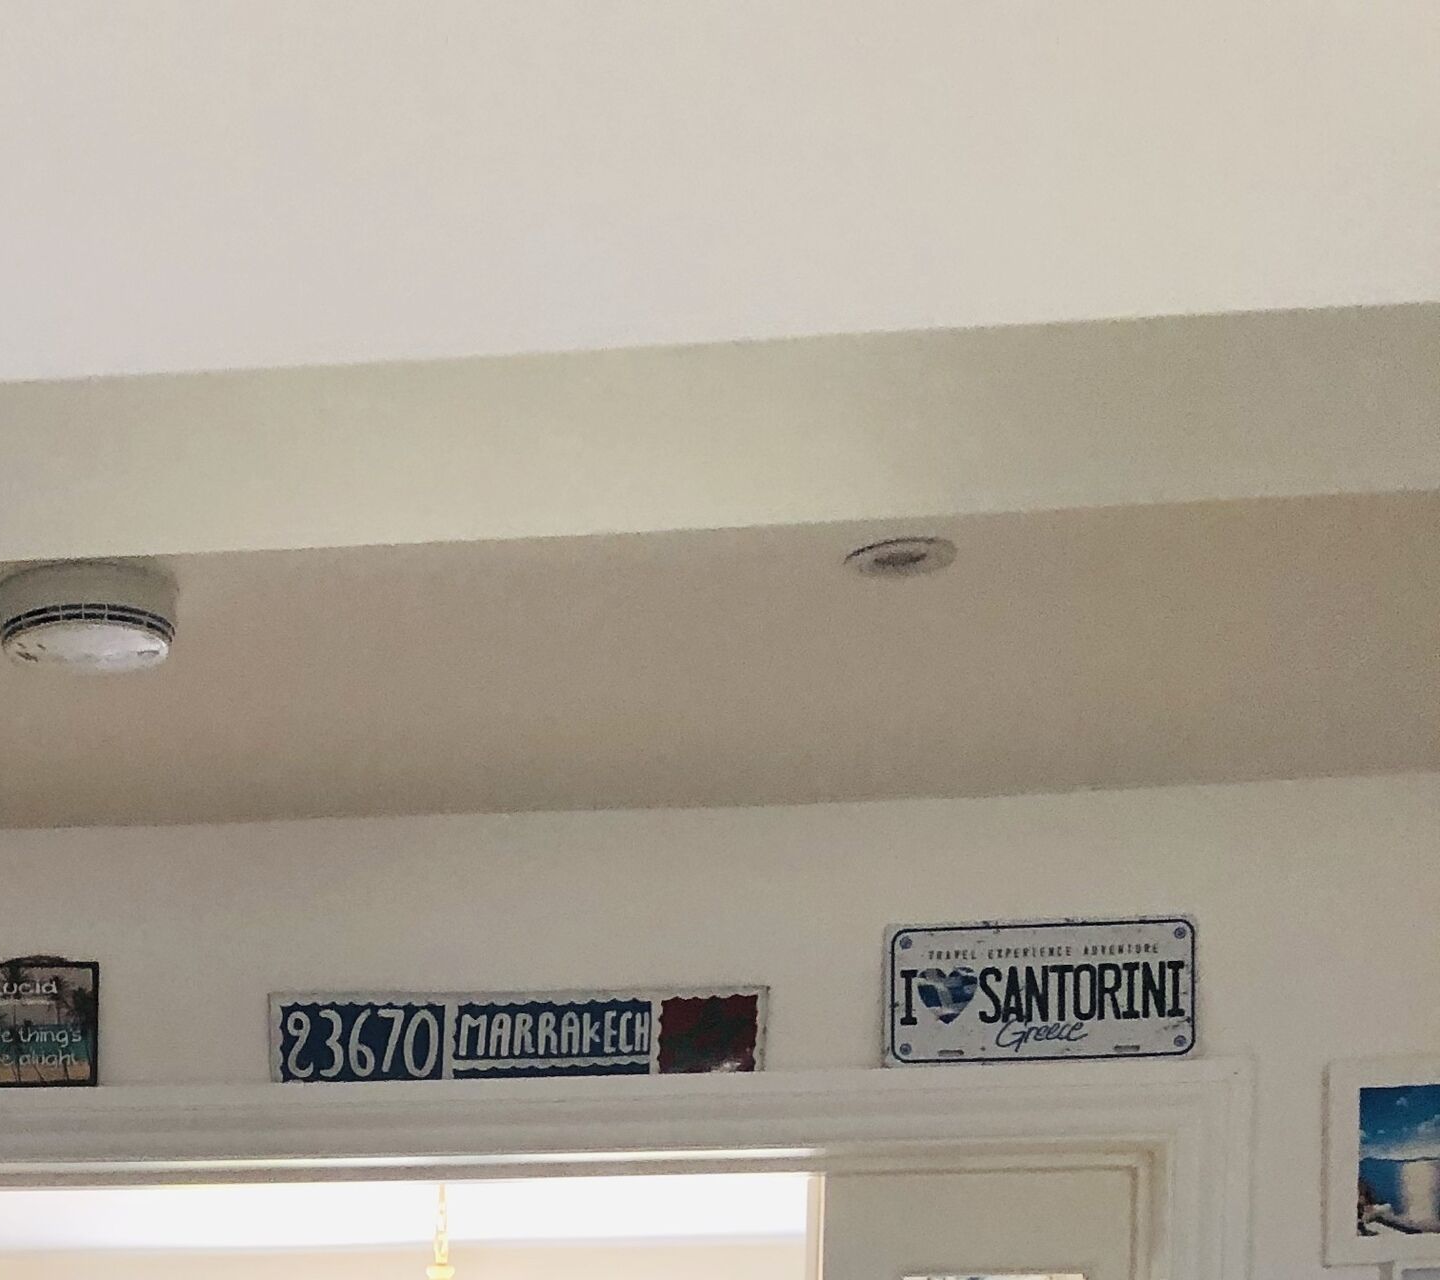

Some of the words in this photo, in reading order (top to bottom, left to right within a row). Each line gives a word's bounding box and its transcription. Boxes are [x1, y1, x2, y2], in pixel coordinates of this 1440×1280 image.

[927, 948, 977, 960] TRAVEL
[987, 945, 1072, 959] EXPERIENCE
[1083, 942, 1159, 955] ADVENTURE
[899, 969, 918, 1026] I
[978, 960, 1186, 1025] SANTORINI
[18, 1026, 82, 1048] thing's
[287, 1008, 440, 1078] 23670
[995, 1019, 1088, 1053] Greece
